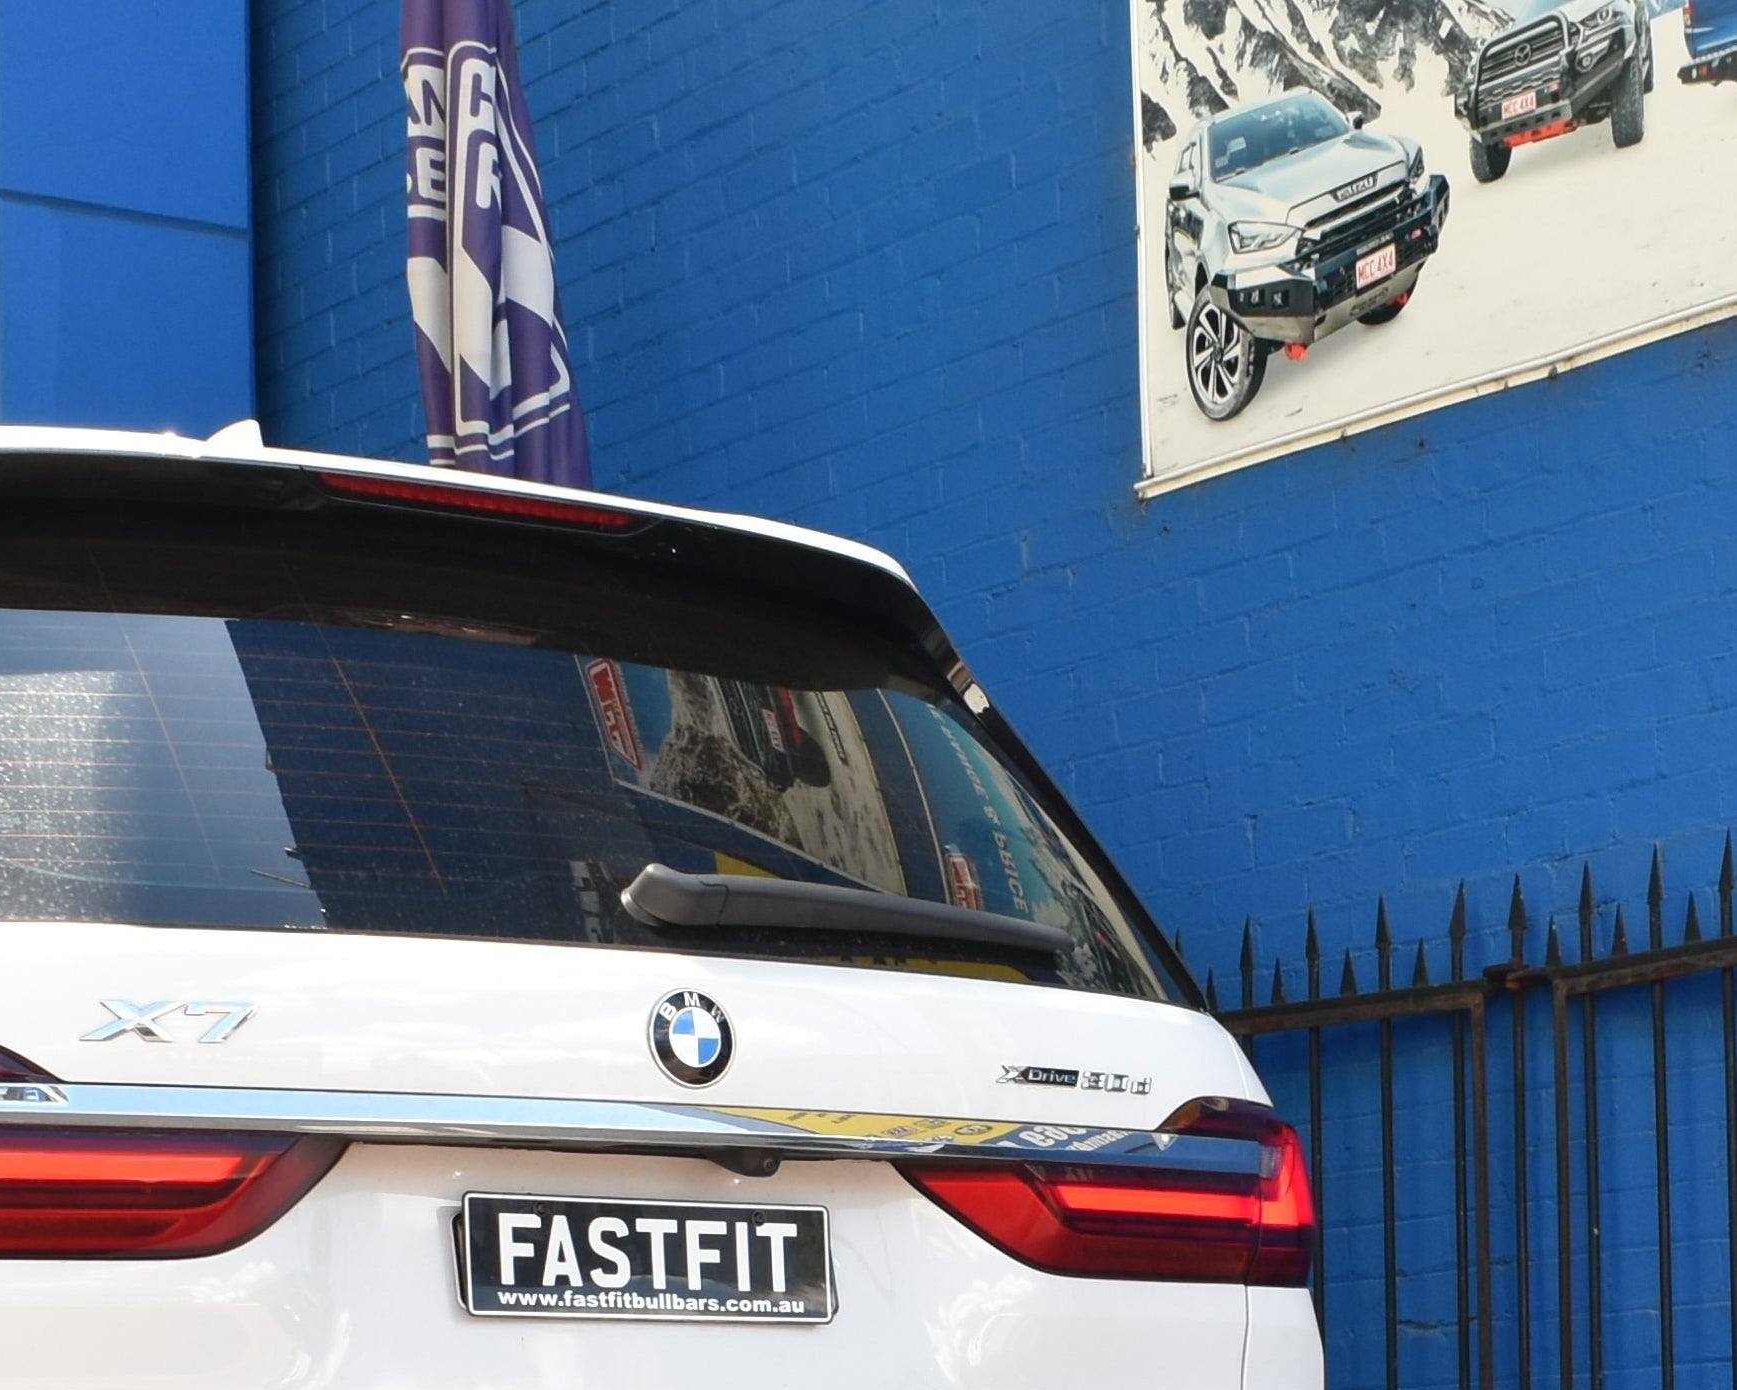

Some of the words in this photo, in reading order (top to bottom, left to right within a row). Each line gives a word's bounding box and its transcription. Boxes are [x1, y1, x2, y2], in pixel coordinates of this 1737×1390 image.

[1357, 259, 1376, 284] MCC
[1376, 249, 1394, 273] 4X4
[77, 999, 258, 1043] X7
[497, 1212, 798, 1293] FASTFIT
[497, 1289, 805, 1314] www.fastfitbullbars.com.au
